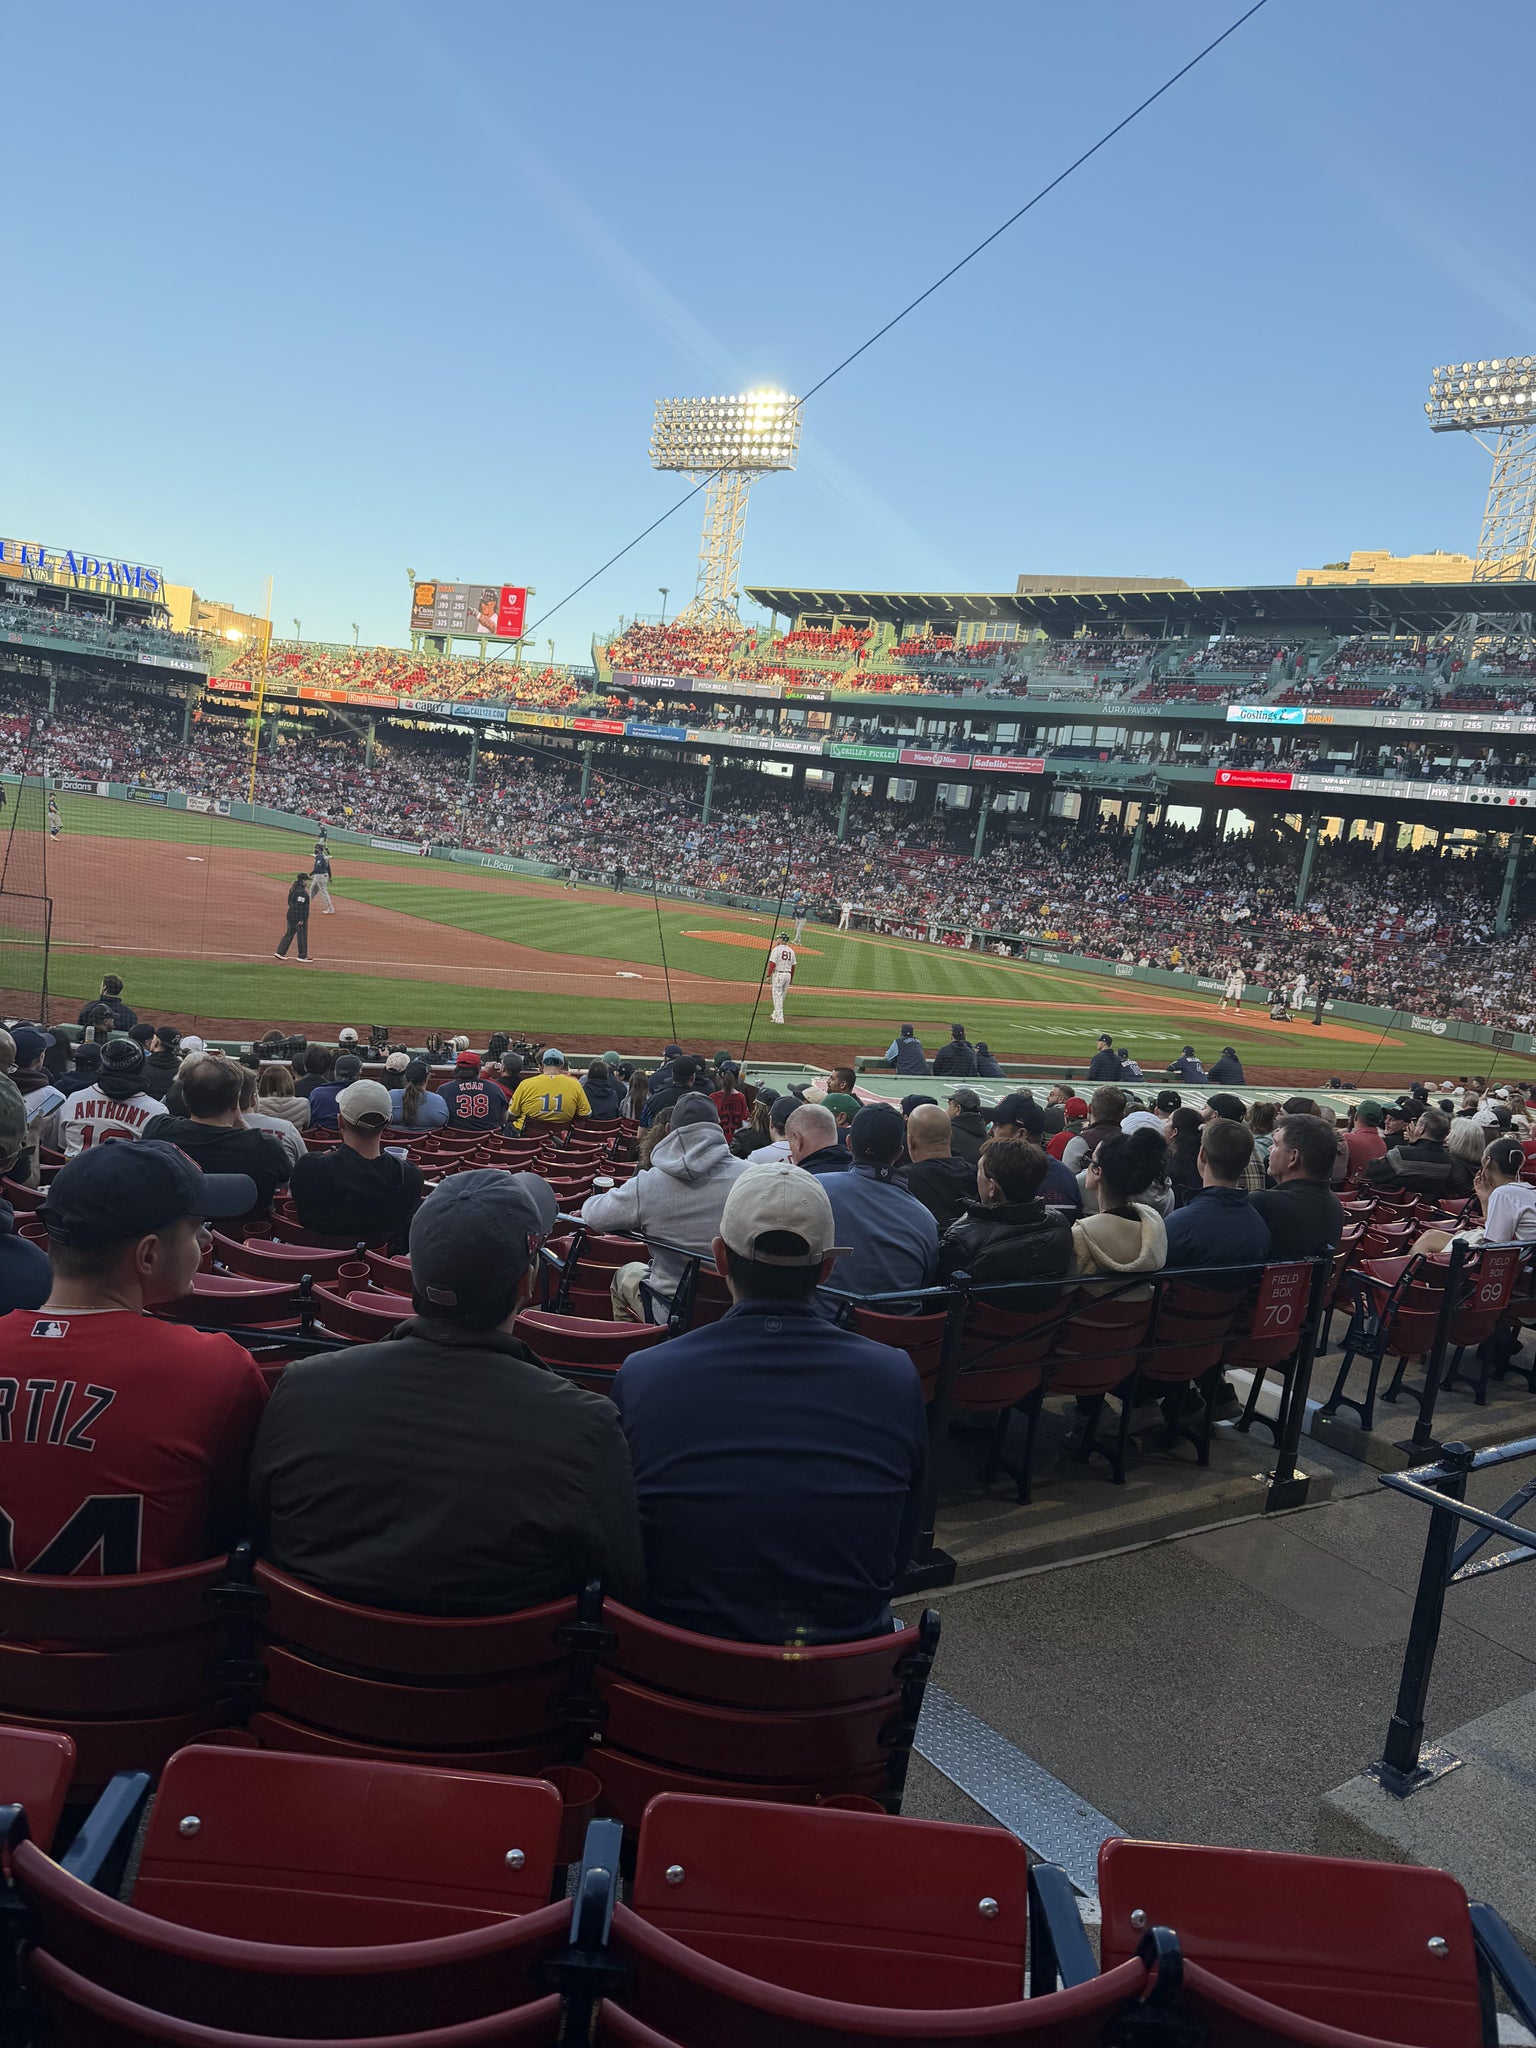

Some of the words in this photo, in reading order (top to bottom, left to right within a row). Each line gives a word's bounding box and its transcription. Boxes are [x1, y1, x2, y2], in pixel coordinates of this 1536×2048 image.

[58, 549, 160, 592] ADAMS
[228, 681, 247, 691] PIZZA
[641, 676, 676, 688] UNITED
[314, 690, 333, 699] STIHL
[1127, 705, 1162, 716] PAVILION
[1239, 709, 1278, 722] Goslings
[1306, 714, 1334, 724] DURAN
[1386, 718, 1397, 726] 32
[1411, 719, 1425, 727] 137
[1437, 720, 1453, 728] .190
[1463, 721, 1482, 729] .255
[1491, 722, 1511, 731] .325
[774, 741, 801, 750] CHANGEUP
[868, 750, 896, 759] PICKLES
[974, 759, 1008, 769] Safelite
[1431, 787, 1450, 797] MVR
[1477, 787, 1496, 796] BALL
[1507, 789, 1532, 798] STRIKE
[781, 950, 792, 962] 81
[1197, 980, 1229, 991] smartwa
[1411, 1021, 1431, 1031] Nine
[1412, 1015, 1433, 1026] Ninety
[456, 1093, 489, 1119] 38
[539, 1093, 564, 1114] 11
[74, 1100, 151, 1128] ANTHONY
[1489, 1256, 1511, 1266] FIELD
[1489, 1268, 1505, 1278] BOX
[1271, 1273, 1299, 1285] FIELD
[1272, 1287, 1293, 1298] BOX
[1480, 1283, 1503, 1302] 69
[1263, 1303, 1292, 1327] 70
[0, 1494, 144, 1576] 4
